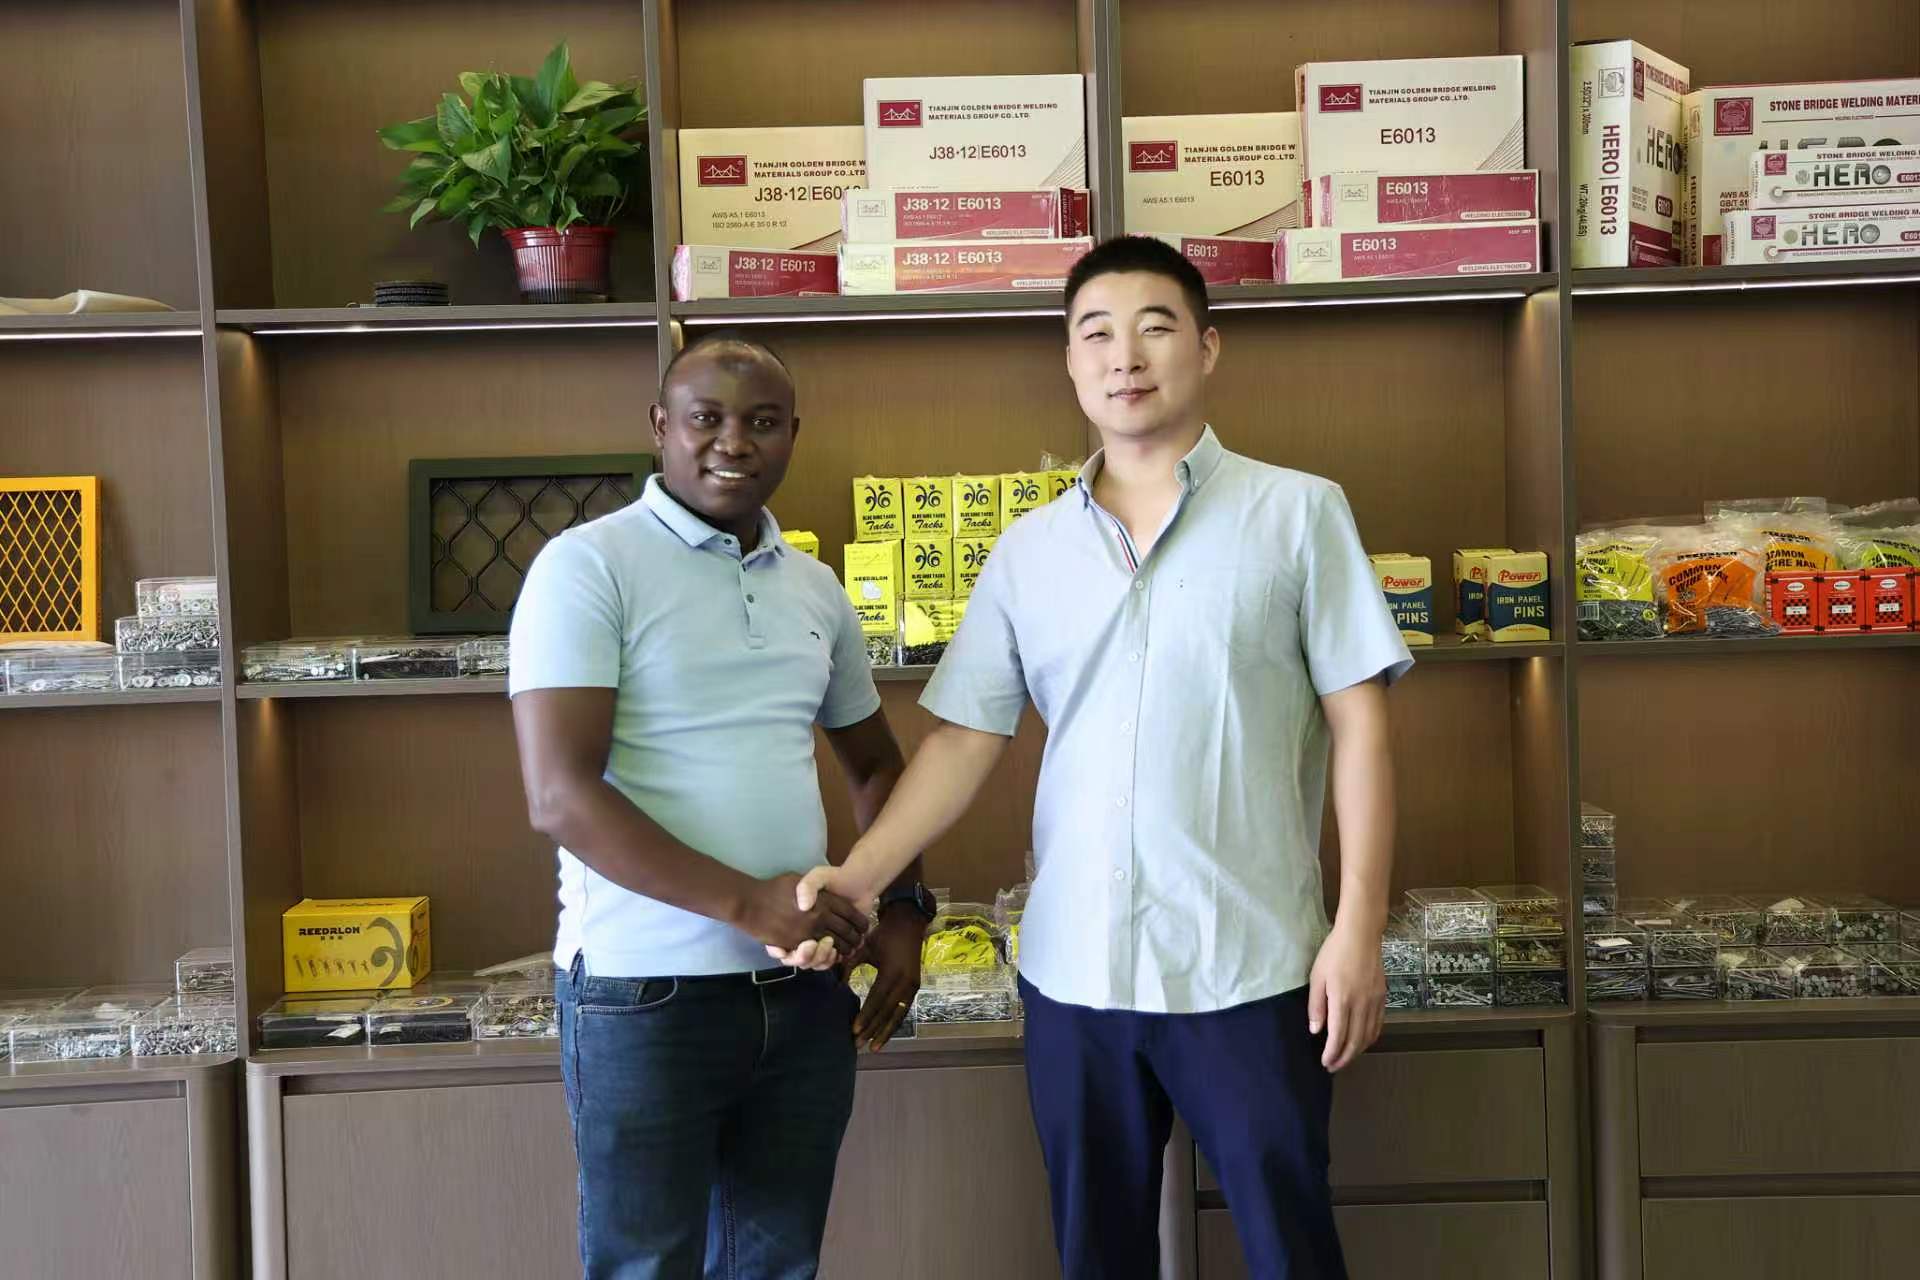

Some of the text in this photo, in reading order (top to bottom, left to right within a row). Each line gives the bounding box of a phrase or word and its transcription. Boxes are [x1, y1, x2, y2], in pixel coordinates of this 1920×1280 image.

[1400, 87, 1431, 95] GOLDEN
[1462, 84, 1497, 92] WELDING
[928, 104, 960, 112] TIANJIN
[1023, 102, 1058, 110] WELDING
[1369, 97, 1411, 105] MATERIALS
[1769, 100, 1801, 112] STONE
[1803, 98, 1838, 110] BRIDGE
[1840, 96, 1884, 109] WELDING
[928, 113, 972, 121] MATERIALS
[1380, 127, 1436, 144] E6013
[981, 144, 1027, 158] E6013
[1184, 146, 1218, 154] TIANJIN
[1219, 145, 1254, 153] GOLDEN
[1816, 152, 1844, 160] STONE
[1846, 151, 1877, 159] BRIDGE
[753, 161, 788, 169] TIANJIN
[789, 160, 824, 168] GOLDEN
[825, 159, 857, 167] BRIDGE
[753, 170, 802, 179] MATERIALS
[803, 169, 832, 178] GROUP
[1210, 170, 1265, 187] E6013
[1600, 124, 1620, 236] HERO E6013
[1813, 163, 1892, 187] HERO
[811, 185, 861, 201] E60
[1386, 181, 1429, 196] E6013
[1720, 191, 1738, 199] AWS
[957, 197, 1002, 210] E6013
[1838, 211, 1870, 219] BRIDGE
[1871, 209, 1910, 217] WELDING
[1801, 223, 1881, 246] HERO
[1187, 244, 1218, 257] E6013
[1352, 238, 1397, 252] E6013
[957, 251, 1003, 265] E6013
[780, 258, 816, 273] E6013
[865, 520, 894, 531] Tacks
[915, 519, 944, 530] Tacks
[963, 517, 992, 527] Tacks
[1384, 575, 1424, 588] Power
[1500, 569, 1540, 582] Power
[914, 579, 944, 589] Tacks
[1401, 601, 1427, 609] PANEL
[1497, 594, 1543, 605] IRON PANEL
[857, 611, 885, 622] Tacks
[1396, 611, 1429, 624] PINS
[1514, 605, 1545, 619] PINS
